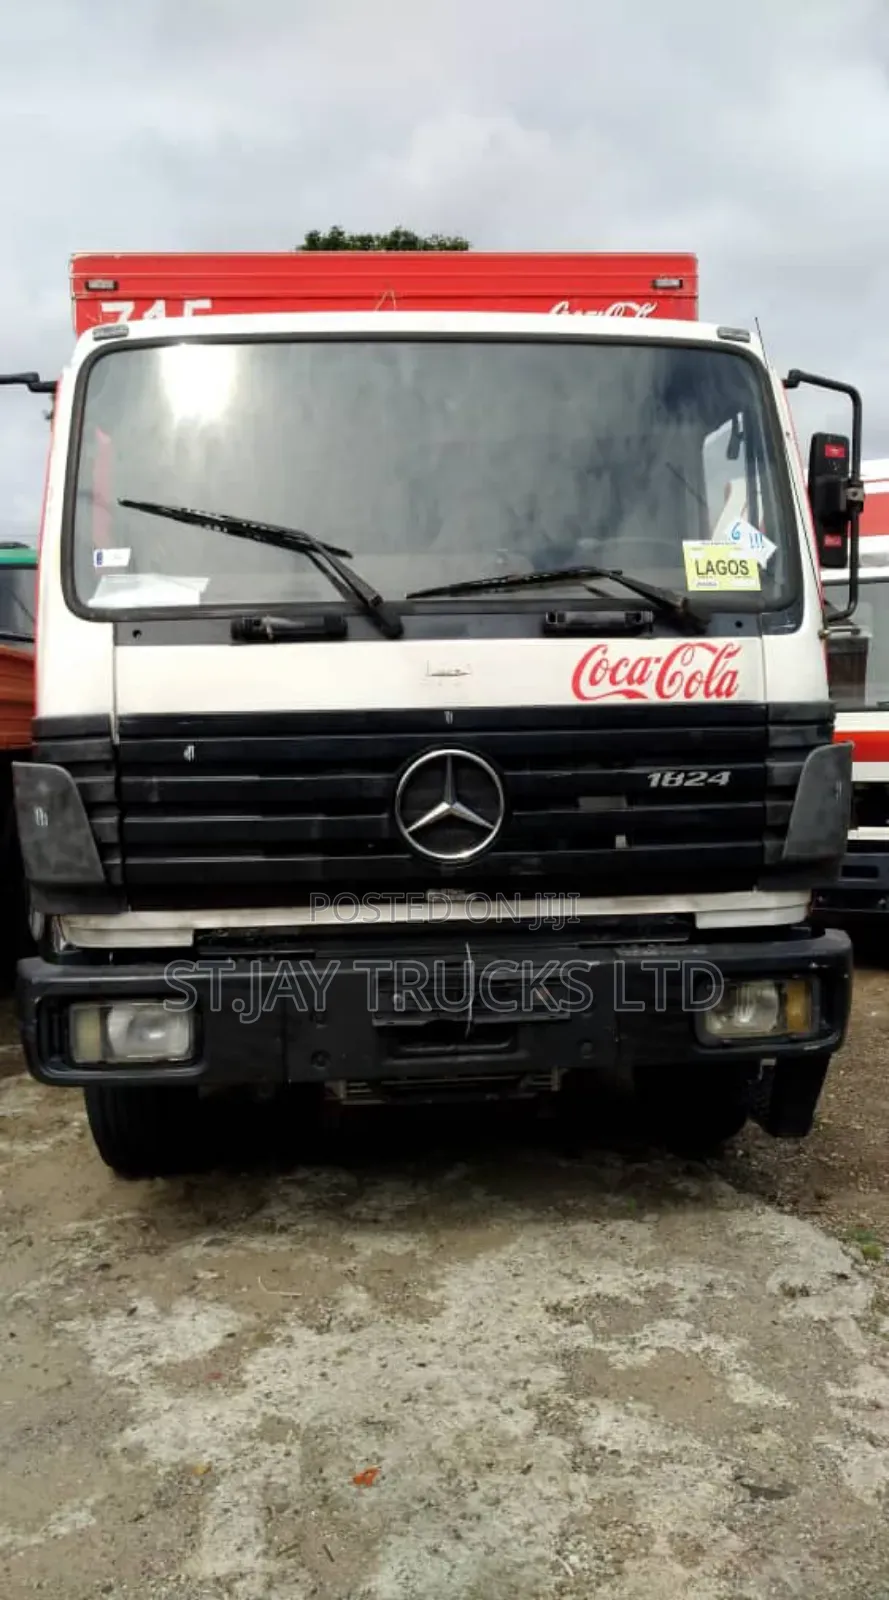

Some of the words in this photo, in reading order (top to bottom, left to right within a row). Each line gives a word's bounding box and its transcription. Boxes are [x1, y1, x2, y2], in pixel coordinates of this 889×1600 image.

[695, 560, 750, 576] LAGOS
[571, 642, 742, 701] Coca-Cola
[647, 771, 731, 787] 1824
